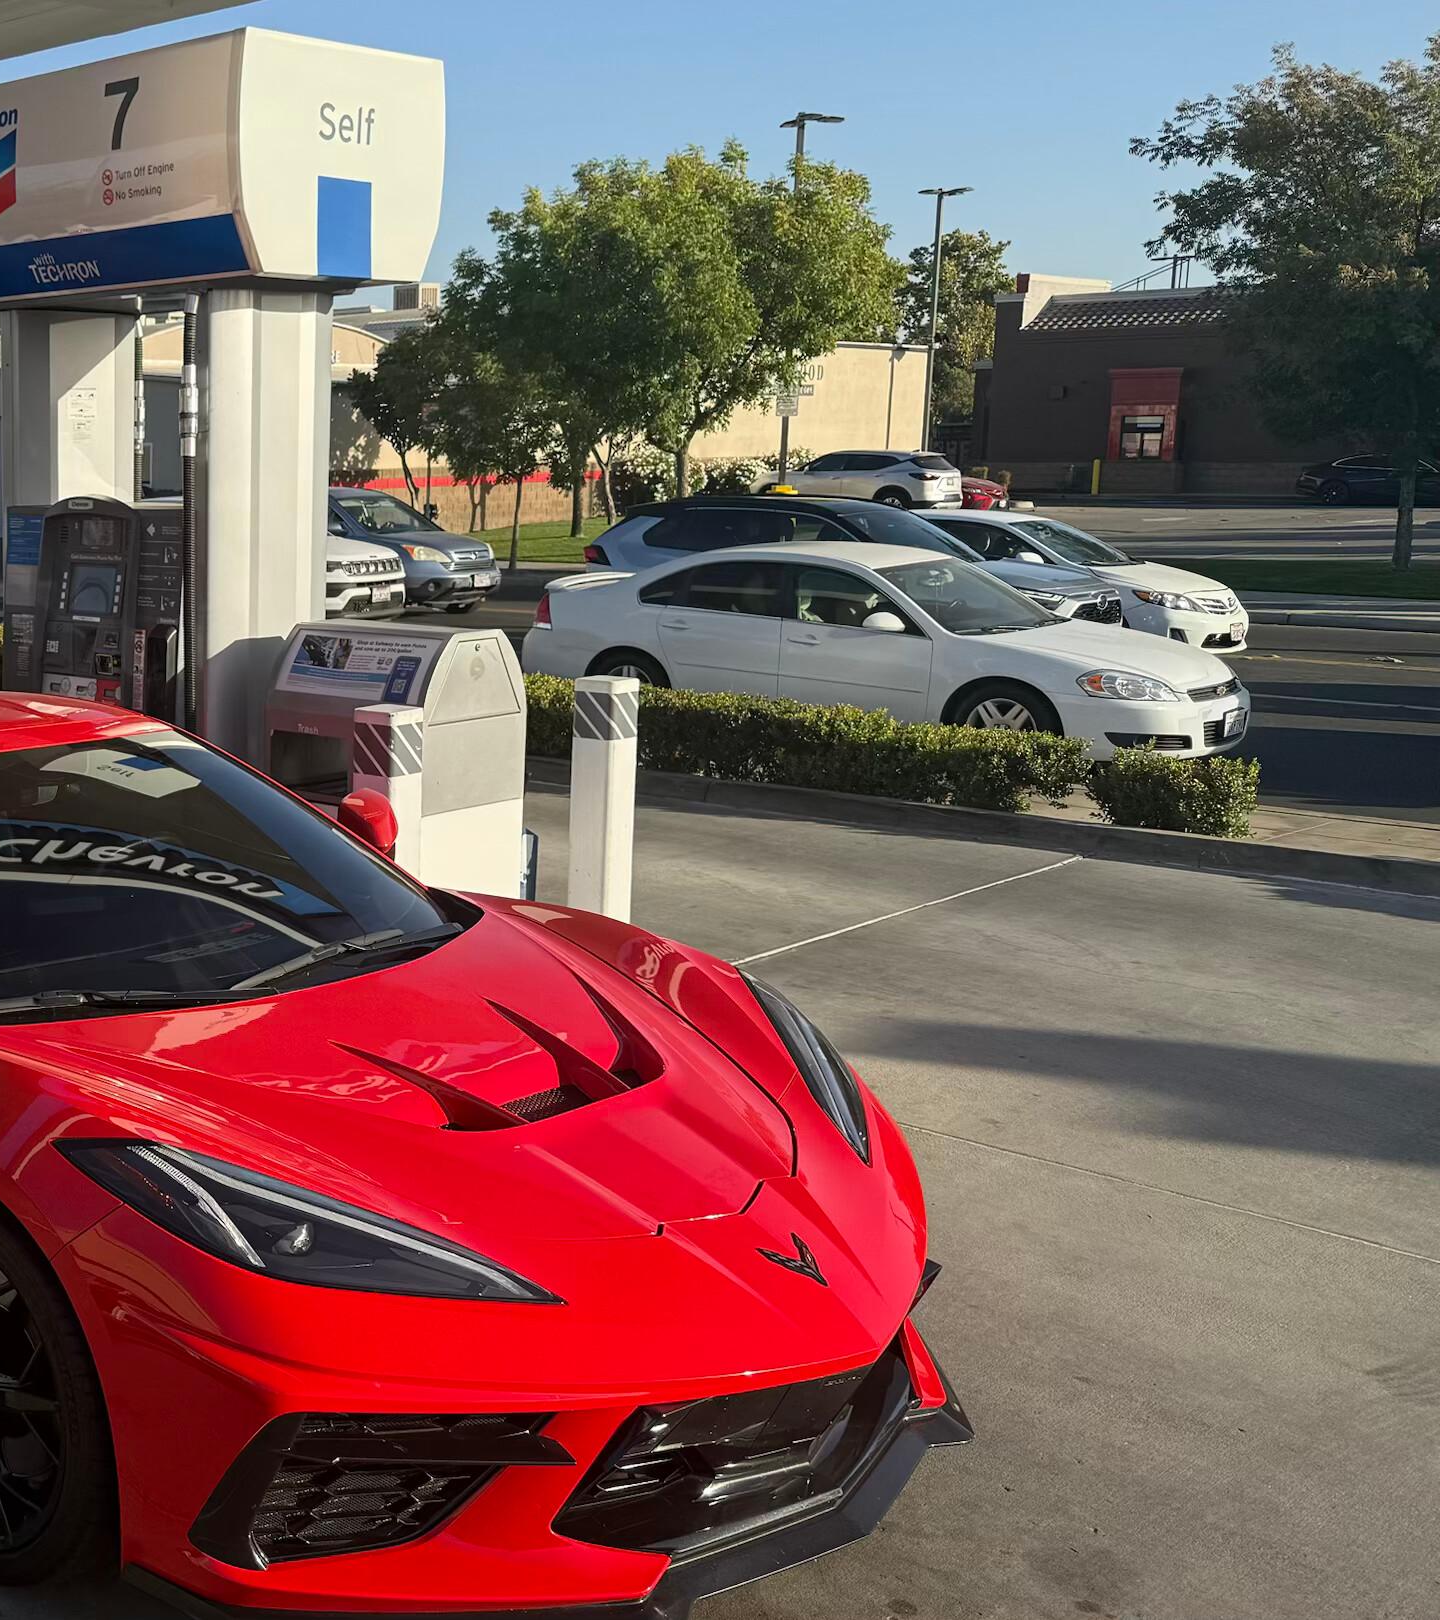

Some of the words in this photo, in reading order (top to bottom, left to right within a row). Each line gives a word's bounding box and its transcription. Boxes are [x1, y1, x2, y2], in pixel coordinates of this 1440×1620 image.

[104, 76, 140, 150] 7
[319, 102, 375, 145] Self
[115, 169, 132, 182] Turn
[134, 167, 146, 178] Off
[147, 162, 175, 175] Engine
[115, 189, 126, 201] No
[128, 185, 162, 199] Smoking
[33, 253, 55, 266] with
[28, 260, 101, 284] TECHRON
